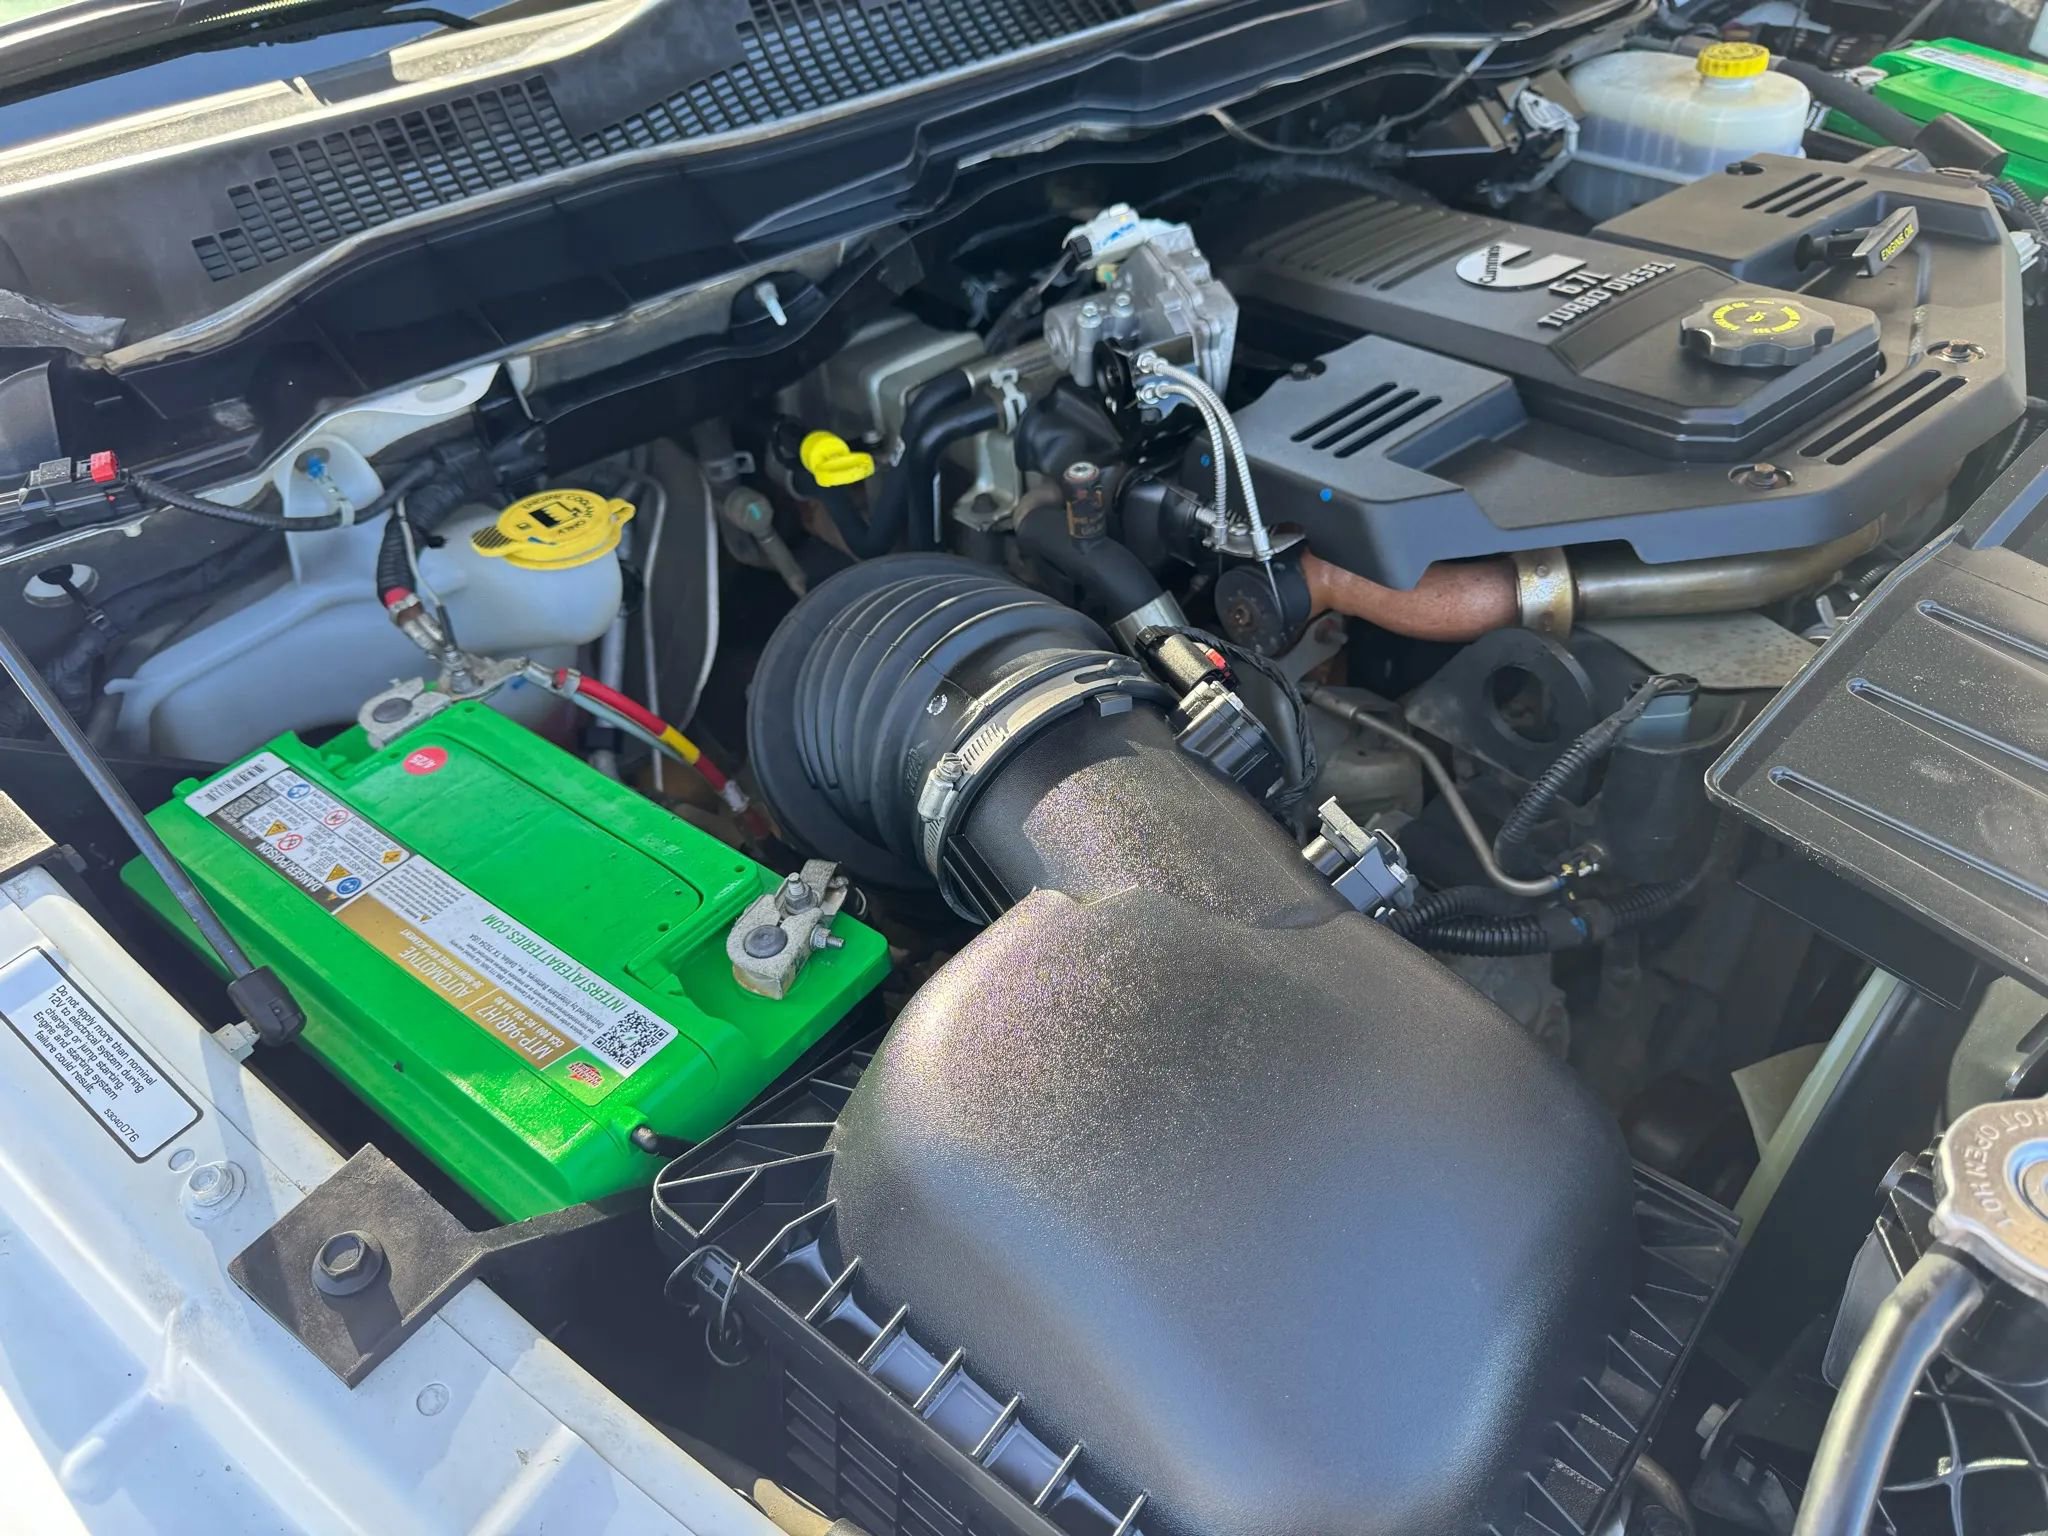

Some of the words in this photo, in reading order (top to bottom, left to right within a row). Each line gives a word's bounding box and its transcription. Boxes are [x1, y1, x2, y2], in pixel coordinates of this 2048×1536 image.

[1881, 233, 1905, 261] ENGINE
[1478, 245, 1501, 284] Cummins
[1537, 288, 1612, 329] TURBO
[1603, 259, 1677, 293] DIESEL
[1548, 269, 1613, 297] 6.7L
[253, 841, 324, 892] DANGER/POISON
[398, 926, 443, 959] REPLACEMENT
[467, 932, 482, 943] USA
[396, 944, 474, 1001] AUTOMOTIVE
[436, 953, 457, 969] FREE
[480, 911, 628, 1015] INTERSTATEBATTERIES.COM
[523, 970, 550, 990] Batteries,
[545, 986, 572, 1006] Interstate
[42, 1005, 75, 1037] charging
[474, 1000, 555, 1061] MTP-94R/H7
[523, 1017, 537, 1027] RC
[573, 1006, 605, 1029] Distributed
[46, 991, 66, 1010] 12V
[59, 1006, 72, 1017] to
[67, 1013, 101, 1047] electrical
[95, 1043, 124, 1071] system
[118, 1067, 146, 1094] during
[55, 983, 69, 997] Do
[64, 994, 80, 1009] not
[74, 1005, 98, 1028] apply
[92, 1023, 114, 1044] more
[110, 1040, 131, 1060] than
[126, 1056, 157, 1086] nominal
[70, 1034, 82, 1045] or
[547, 1033, 565, 1048] CCA
[30, 1010, 58, 1037] Engine
[52, 1032, 70, 1049] and
[63, 1045, 96, 1077] starting
[89, 1072, 119, 1102] system
[33, 1029, 59, 1054] failure
[53, 1049, 76, 1072] could
[70, 1068, 97, 1095] result.
[75, 1041, 99, 1064] jump
[92, 1059, 127, 1092] starting.
[566, 1063, 600, 1088] INTERSTATE
[574, 1061, 603, 1082] BATTERIES
[101, 1105, 140, 1144] 53040076
[1964, 1124, 2000, 1177] OPEN
[1969, 1182, 2016, 1229] HOT
